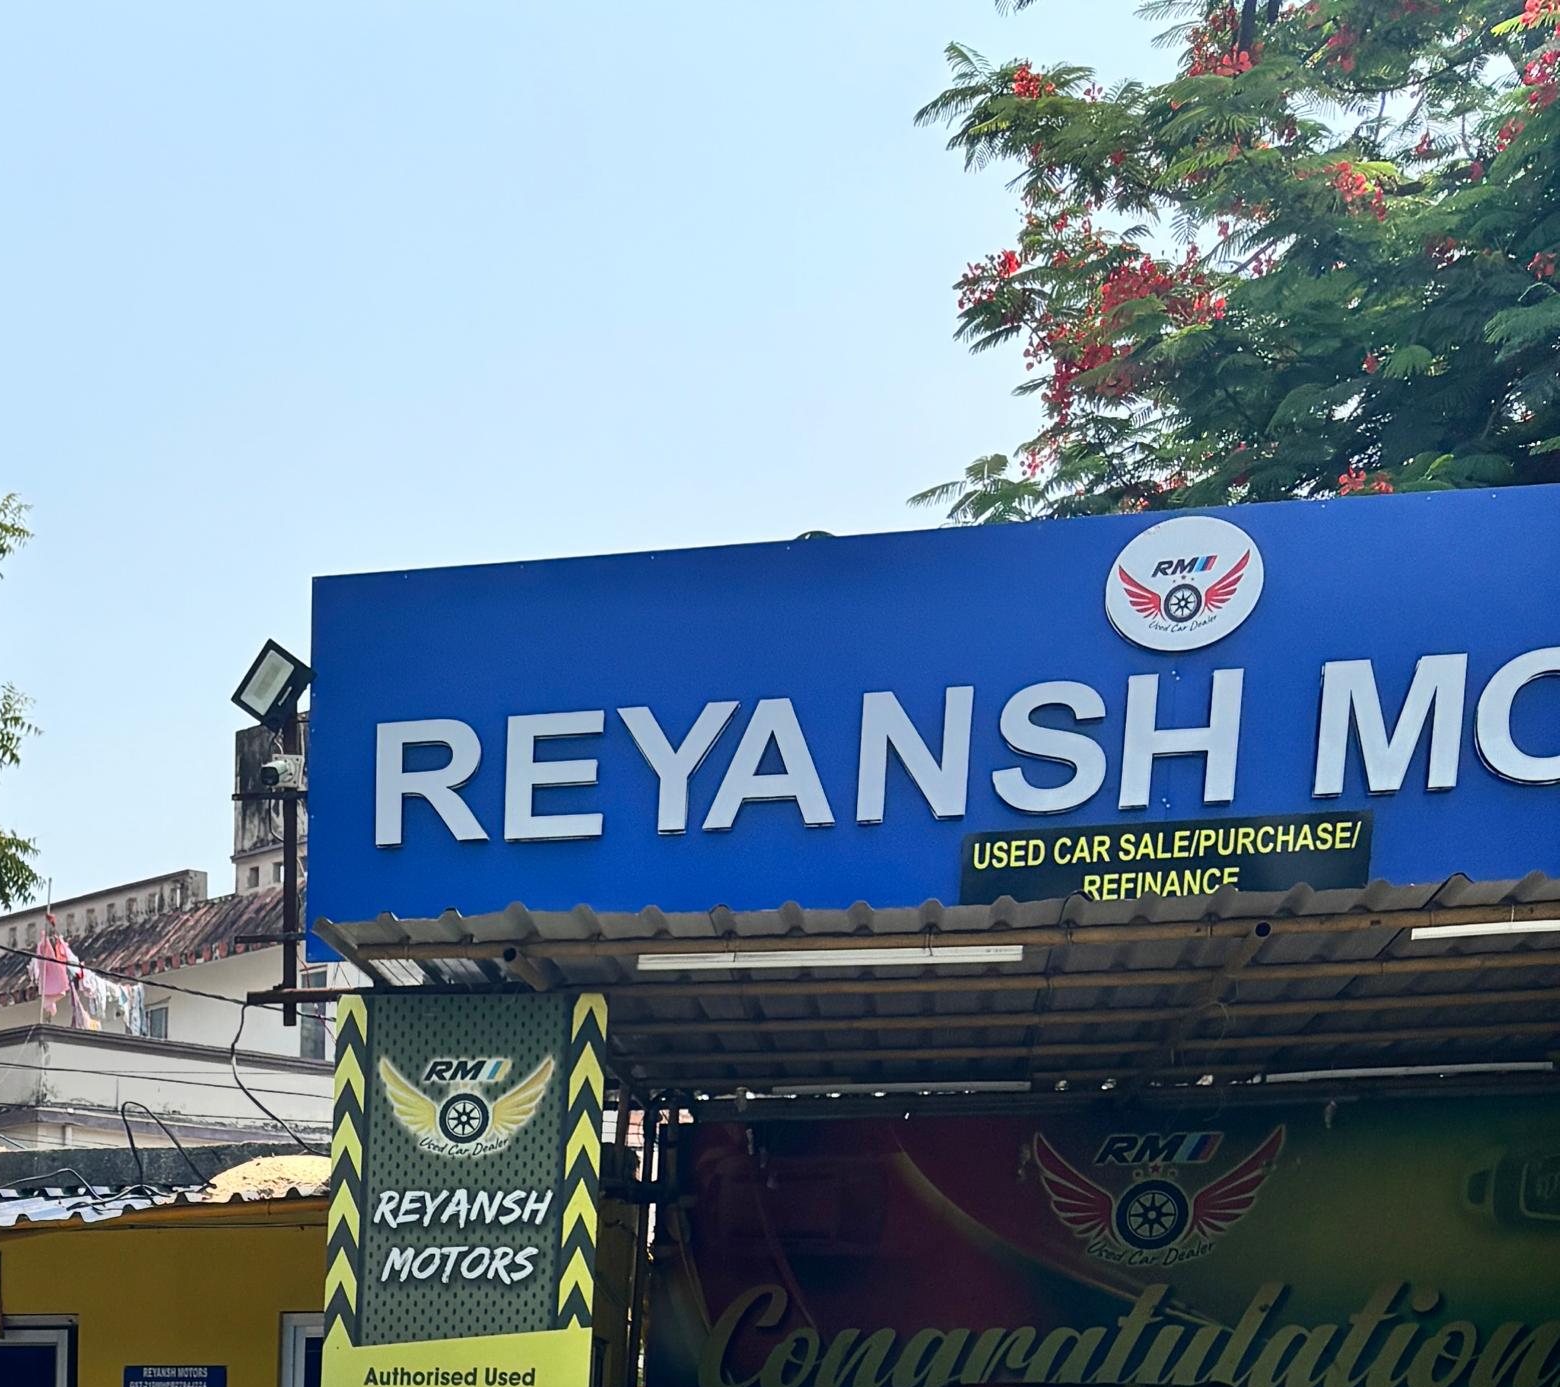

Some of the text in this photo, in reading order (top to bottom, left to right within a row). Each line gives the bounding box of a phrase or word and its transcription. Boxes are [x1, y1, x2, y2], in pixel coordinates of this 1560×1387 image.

[1170, 621, 1187, 633] Car
[1190, 615, 1217, 631] Dealer
[374, 668, 1244, 847] REYANSH
[973, 821, 1362, 869] USED CAR SALE/PURCHASE/
[1083, 867, 1240, 901] REFINANCE
[420, 1137, 509, 1156] Used Car Dealer
[374, 1188, 554, 1228] REYANSH
[381, 1245, 540, 1285] MOTORS
[1088, 1240, 1214, 1266] Used Car Dealer
[143, 1367, 208, 1378] REYANSH MOTORS
[364, 1366, 536, 1387] Authorised Used
